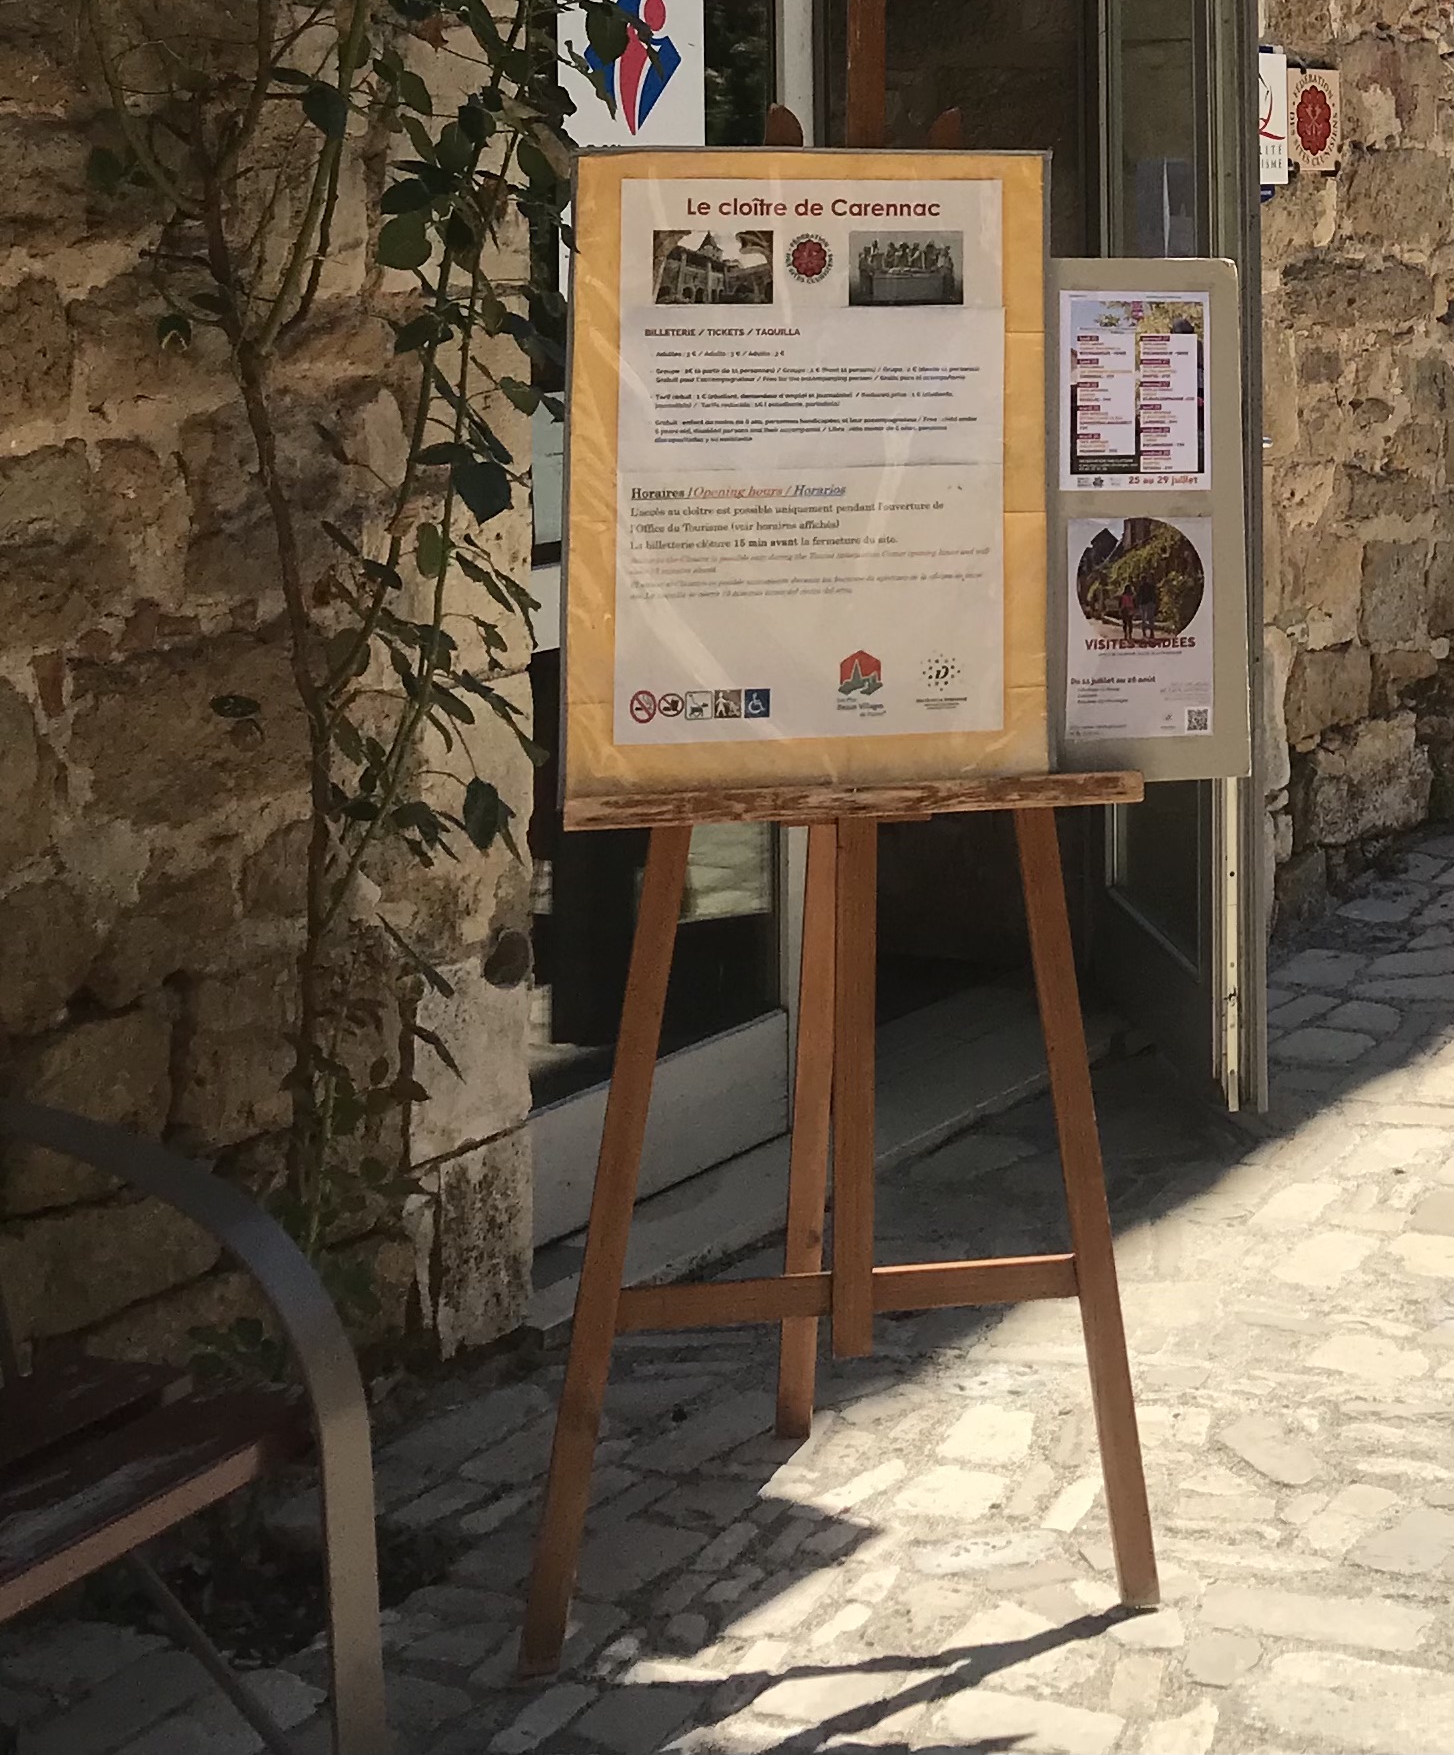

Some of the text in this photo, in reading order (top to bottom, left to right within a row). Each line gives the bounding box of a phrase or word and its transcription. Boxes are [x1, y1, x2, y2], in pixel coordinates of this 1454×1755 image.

[687, 198, 941, 217] Le cloître de Carennac
[707, 328, 745, 336] TICKETS
[756, 328, 801, 336] TAQUILLA
[1128, 475, 1198, 486] 25 au 29 juillet
[631, 487, 685, 499] Horaires
[748, 486, 783, 497] hours
[794, 484, 846, 496] Horarios
[716, 507, 730, 515] est
[733, 505, 772, 516] possible
[775, 504, 833, 515] uniquement
[836, 503, 875, 514] pendant
[932, 501, 944, 509] de
[667, 523, 680, 532] du
[682, 522, 728, 533] Tourisme
[734, 539, 746, 548] 15
[748, 538, 767, 547] min
[770, 538, 798, 547] avant
[801, 537, 810, 546] la
[812, 536, 861, 546] fermeture
[863, 535, 875, 544] du
[1085, 637, 1136, 651] VISITES
